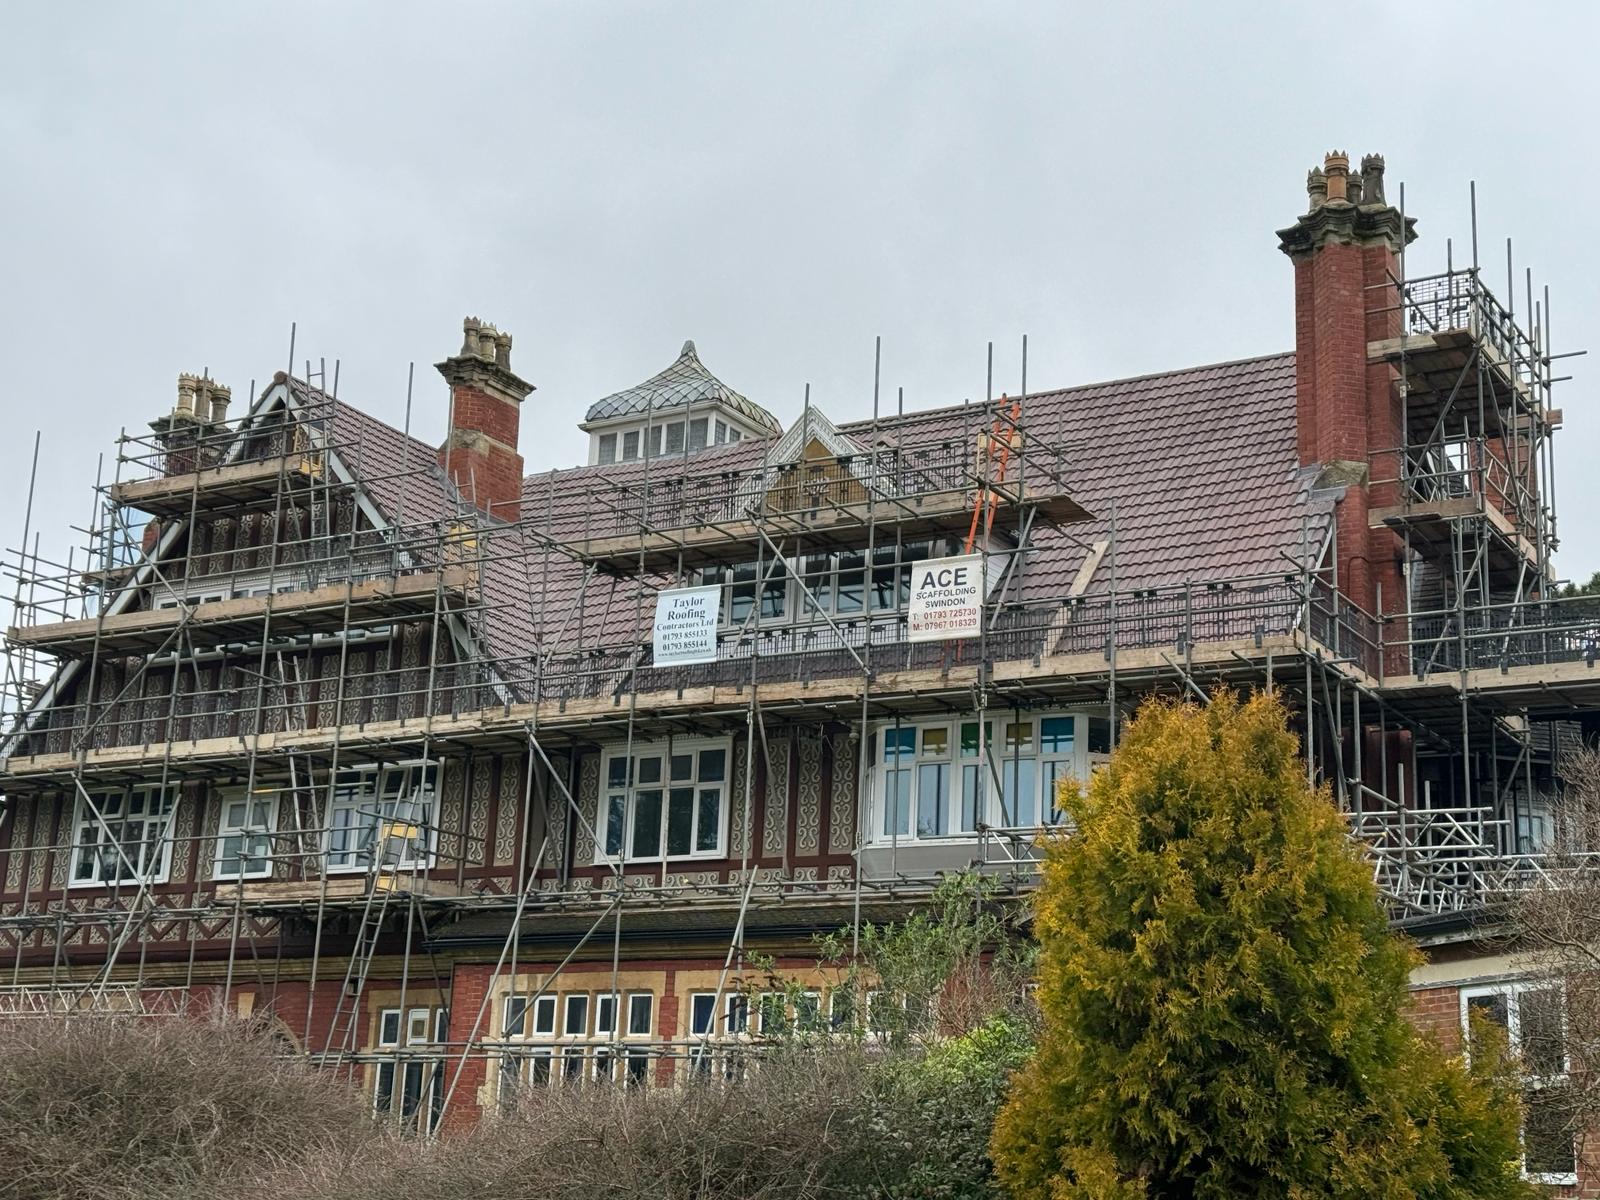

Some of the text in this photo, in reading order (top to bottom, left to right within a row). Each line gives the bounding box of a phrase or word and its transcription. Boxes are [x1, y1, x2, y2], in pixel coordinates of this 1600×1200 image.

[920, 567, 968, 590] ACE
[916, 586, 976, 600] SCAFFOLDING
[673, 597, 705, 609] Taylor
[925, 598, 966, 608] SWINDON
[667, 609, 706, 620] Roofing
[924, 610, 947, 620] 01793
[949, 608, 977, 617] 725730
[656, 618, 714, 631] Contractors Ltd
[913, 618, 977, 631] M: 07967 018329
[662, 629, 708, 641] 01793 855133
[662, 639, 708, 651] 01793 855144
